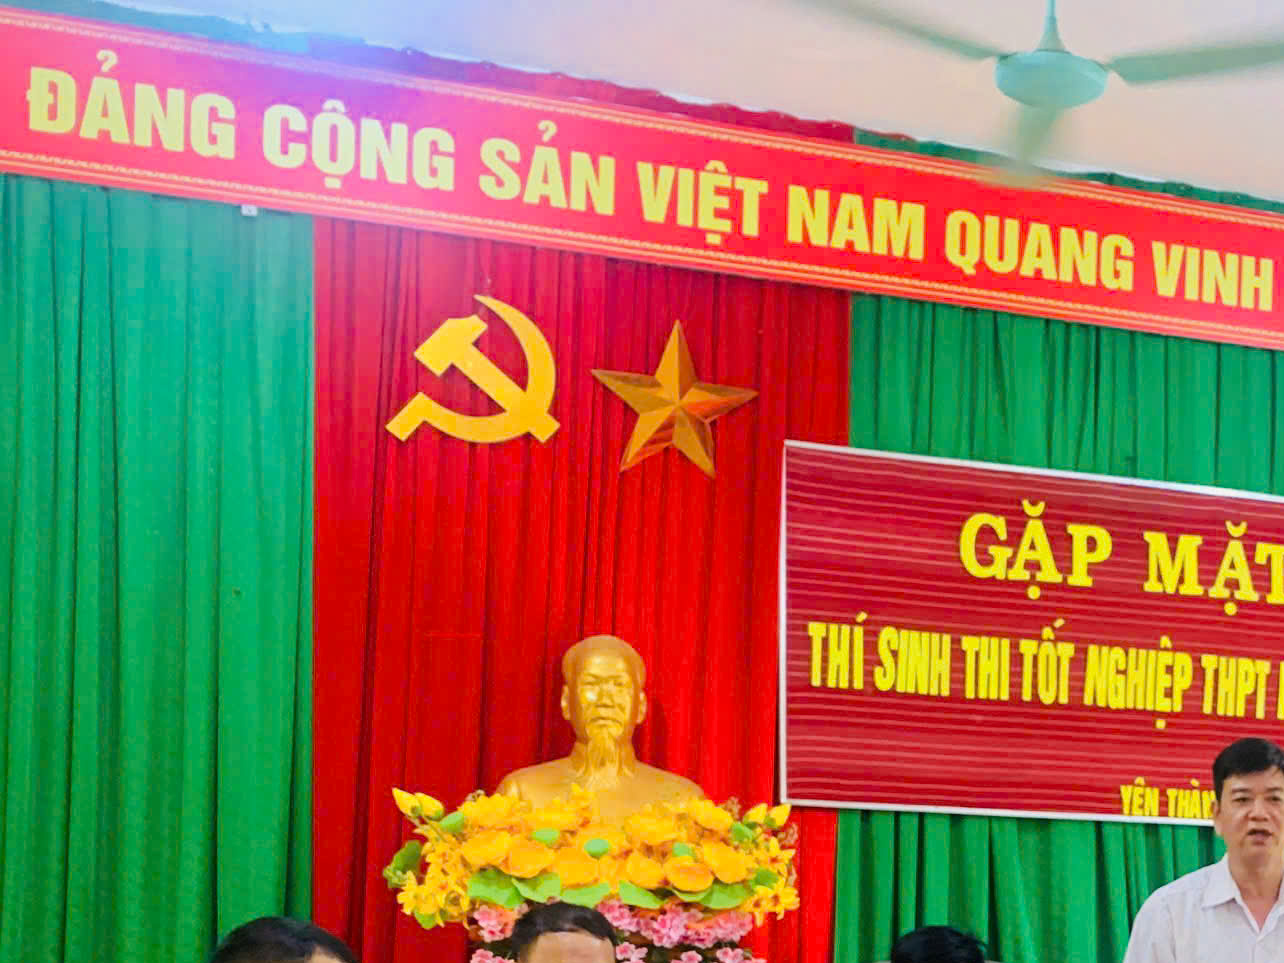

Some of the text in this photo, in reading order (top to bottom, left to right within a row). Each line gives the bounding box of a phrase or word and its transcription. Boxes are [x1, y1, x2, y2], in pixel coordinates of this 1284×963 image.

[27, 49, 236, 160] ĐẢNG
[263, 99, 456, 191] CỘNG
[479, 120, 615, 216] SẢN
[637, 160, 769, 246] VIỆT
[787, 185, 925, 262] NAM
[945, 209, 1135, 301] QUANG
[1151, 241, 1273, 313] VINH
[959, 499, 1113, 600] GẶP
[807, 611, 869, 690] THÍ
[874, 626, 951, 697] SINH
[961, 634, 1010, 701] THI
[1019, 617, 1077, 705] TỐT
[1084, 635, 1193, 730] NGHIỆP
[1201, 653, 1270, 719] THPT
[1120, 776, 1160, 817] YÊN
[1166, 778, 1216, 819] THÀN
